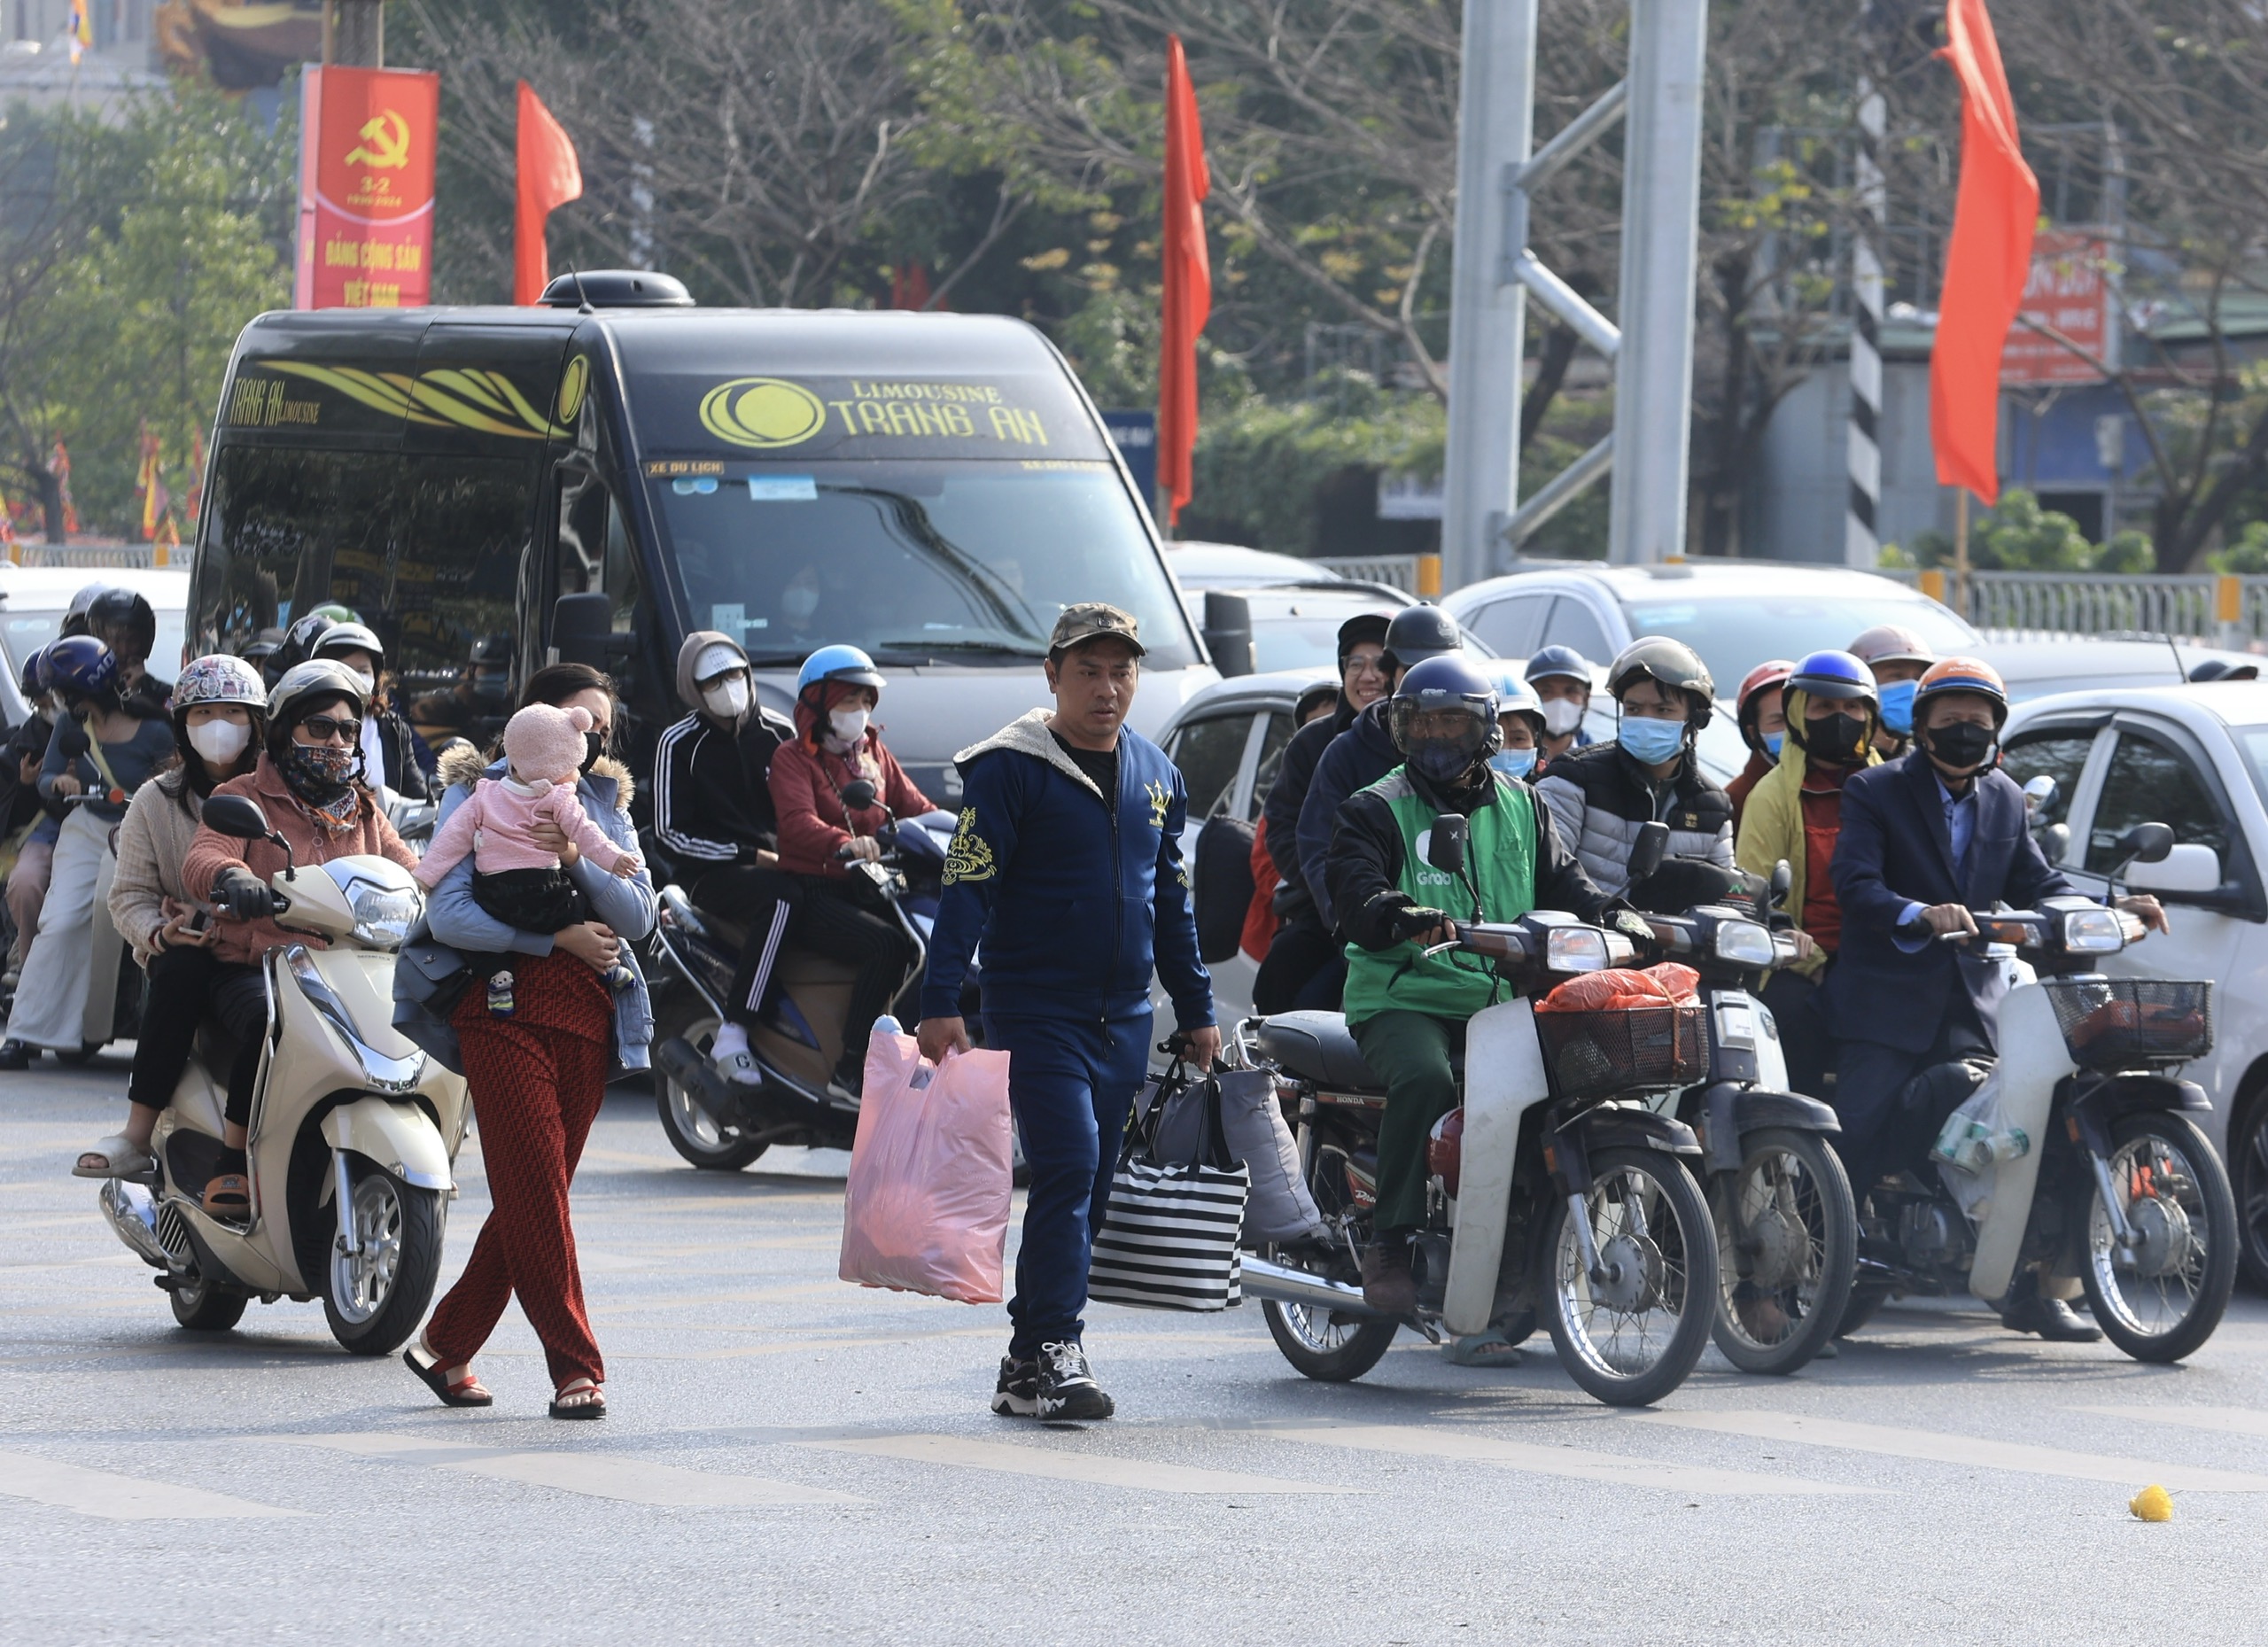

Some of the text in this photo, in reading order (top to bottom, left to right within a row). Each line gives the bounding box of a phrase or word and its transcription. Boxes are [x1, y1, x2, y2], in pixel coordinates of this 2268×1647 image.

[229, 377, 266, 425] TRANG
[850, 380, 1003, 404] LIMOUSINE
[828, 400, 1049, 446] TRANG AN
[650, 462, 666, 474] XE
[1417, 872, 1452, 886] Grab
[1336, 1096, 1364, 1105] HONDA
